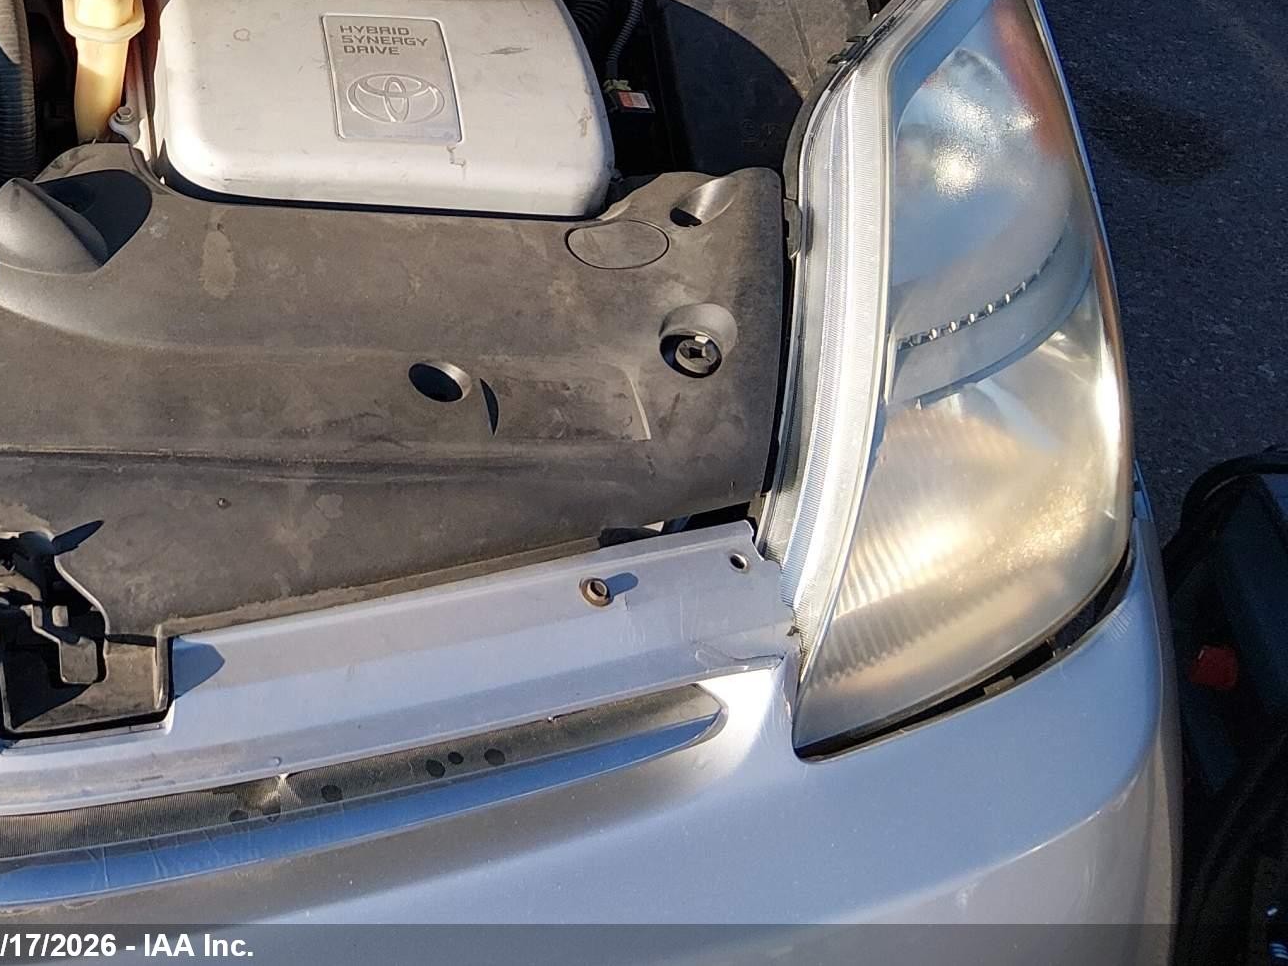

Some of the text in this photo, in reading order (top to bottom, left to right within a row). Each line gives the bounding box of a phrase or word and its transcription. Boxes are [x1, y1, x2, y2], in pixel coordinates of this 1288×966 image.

[339, 25, 410, 36] HYBRID
[341, 35, 429, 47] SYNERGY
[343, 45, 401, 56] DRIVE
